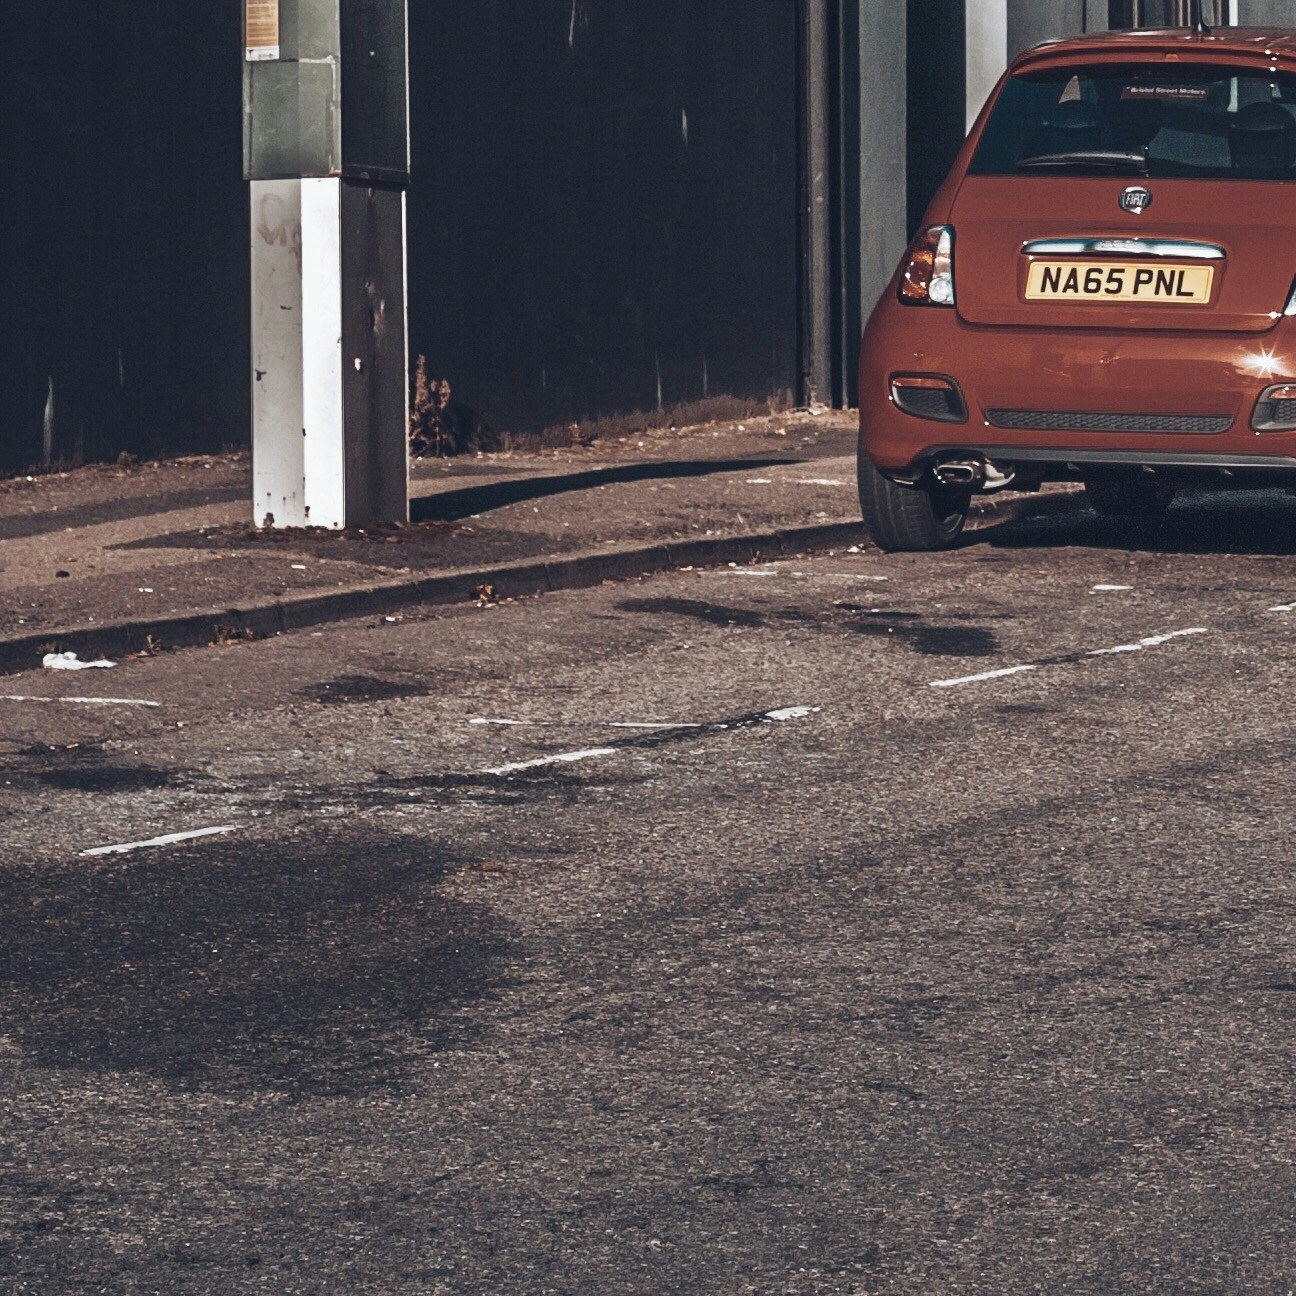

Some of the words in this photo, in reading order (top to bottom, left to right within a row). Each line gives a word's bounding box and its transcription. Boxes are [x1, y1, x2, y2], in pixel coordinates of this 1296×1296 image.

[1125, 192, 1146, 206] FIAT
[1040, 266, 1126, 295] NA65
[1132, 268, 1194, 297] PNL
